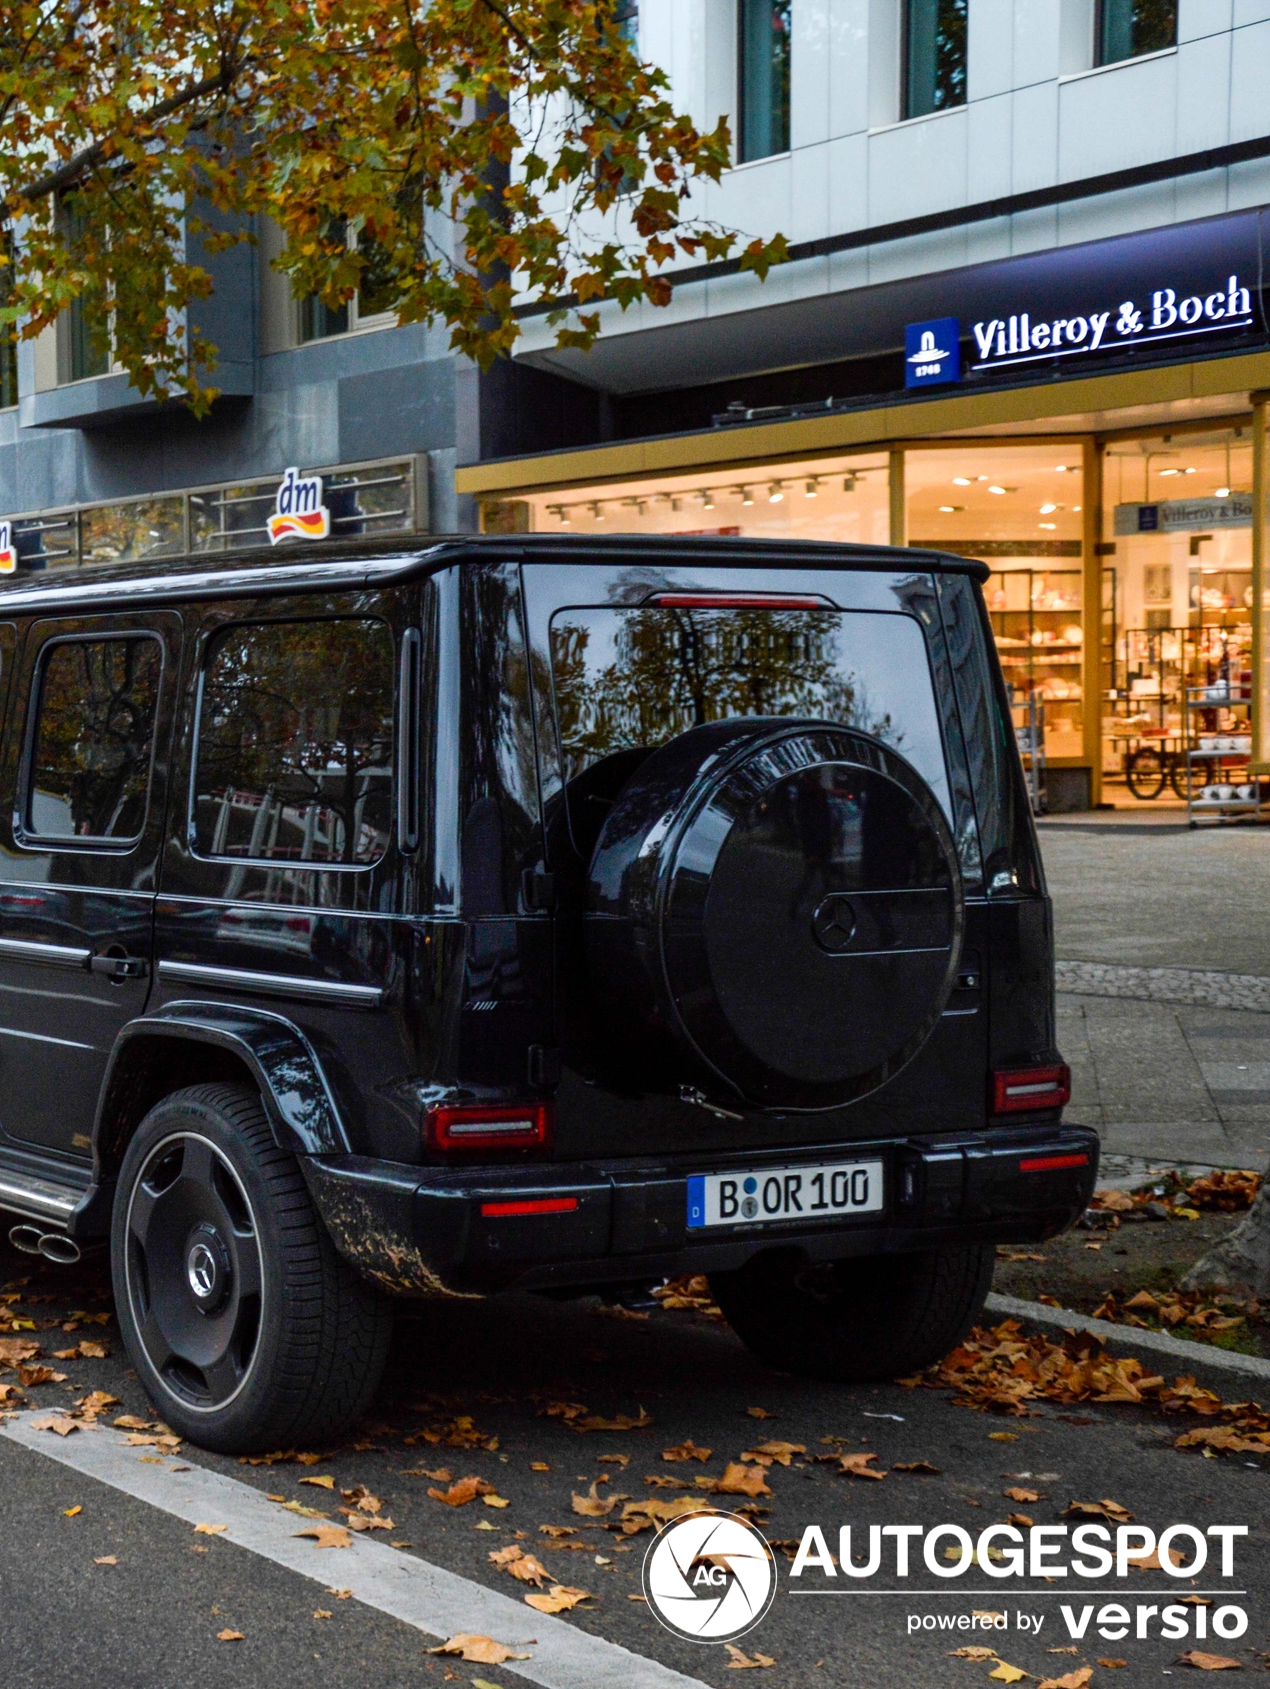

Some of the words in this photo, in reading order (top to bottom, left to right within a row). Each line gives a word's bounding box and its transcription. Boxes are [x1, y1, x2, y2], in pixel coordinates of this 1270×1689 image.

[973, 312, 1110, 360] Villeroy
[1116, 301, 1144, 335] &
[1148, 275, 1252, 331] Boch
[279, 472, 317, 514] dm
[1163, 505, 1215, 522] Villeroy
[692, 1207, 699, 1218] D
[720, 1180, 738, 1218] B
